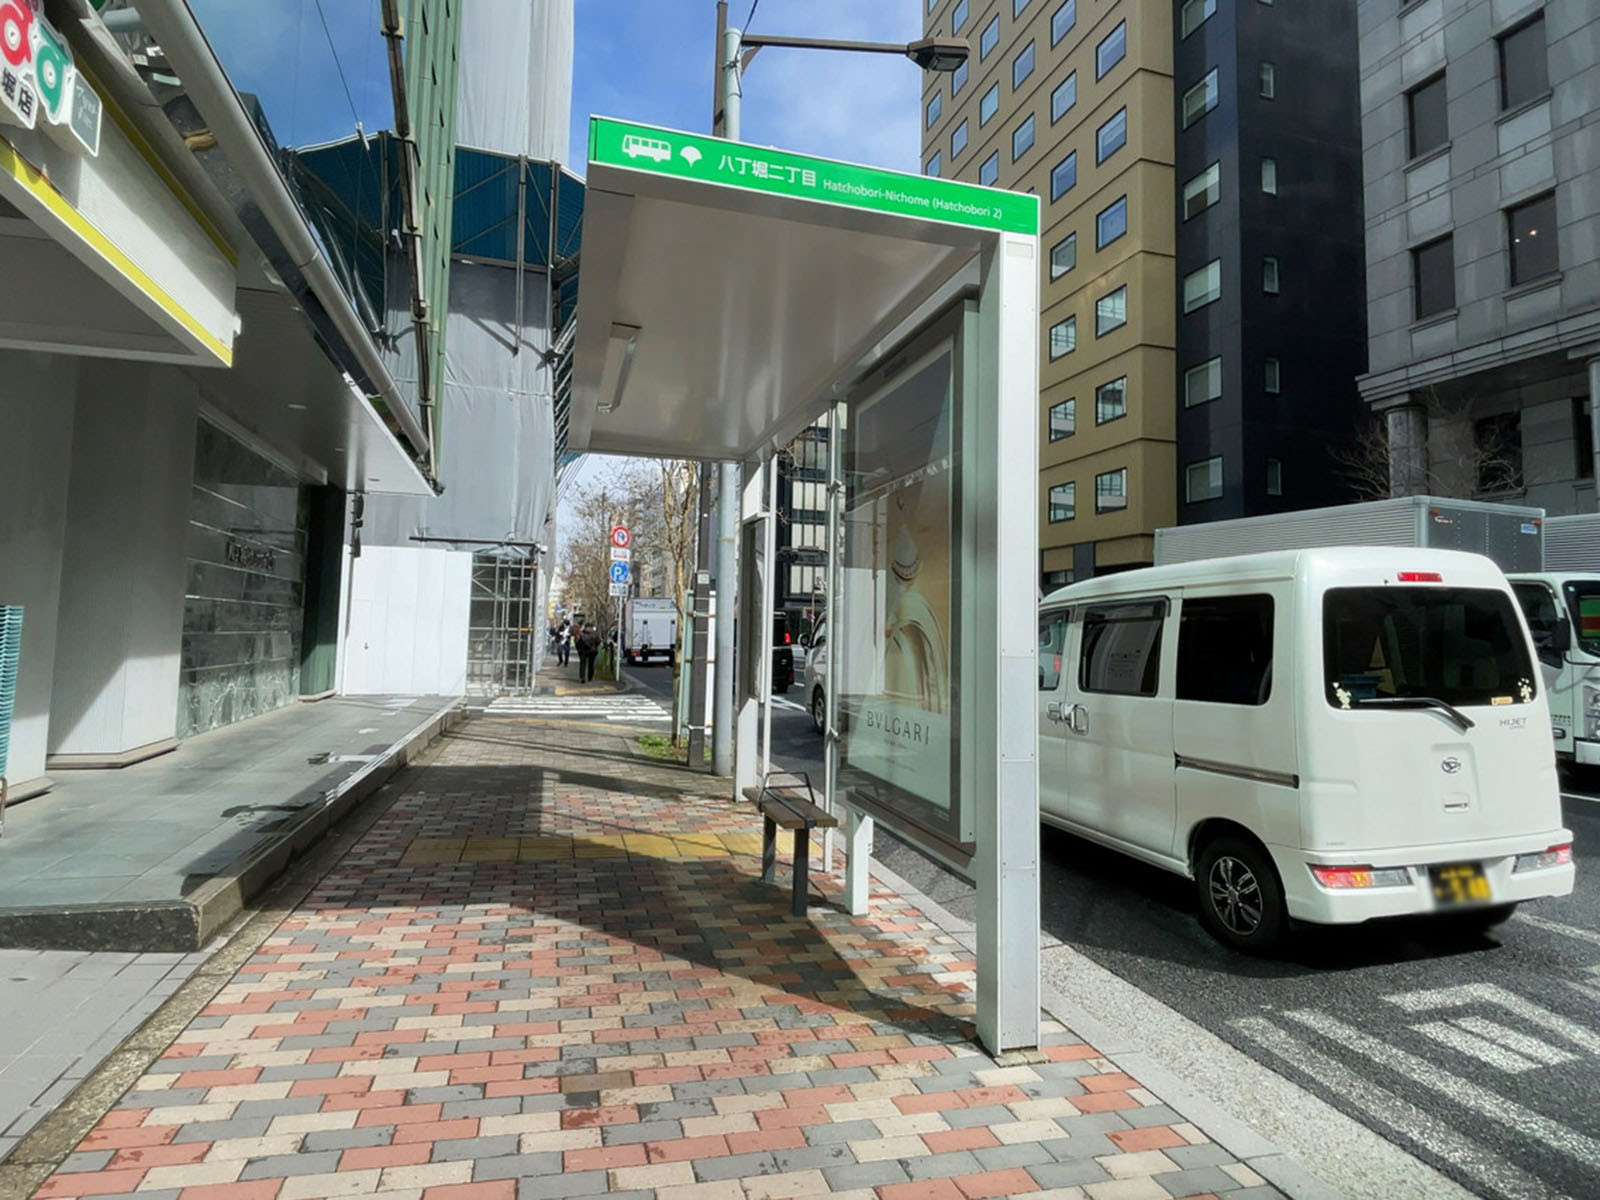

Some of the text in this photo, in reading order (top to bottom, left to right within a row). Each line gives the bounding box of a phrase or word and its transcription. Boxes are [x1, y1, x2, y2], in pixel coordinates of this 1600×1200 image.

[718, 155, 816, 187] 八丁堀二丁目
[823, 179, 1002, 219] Hatchobori-Nichome (Hatchobori 2)
[867, 711, 930, 744] BVLGARI
[1500, 718, 1527, 726] HIJET
